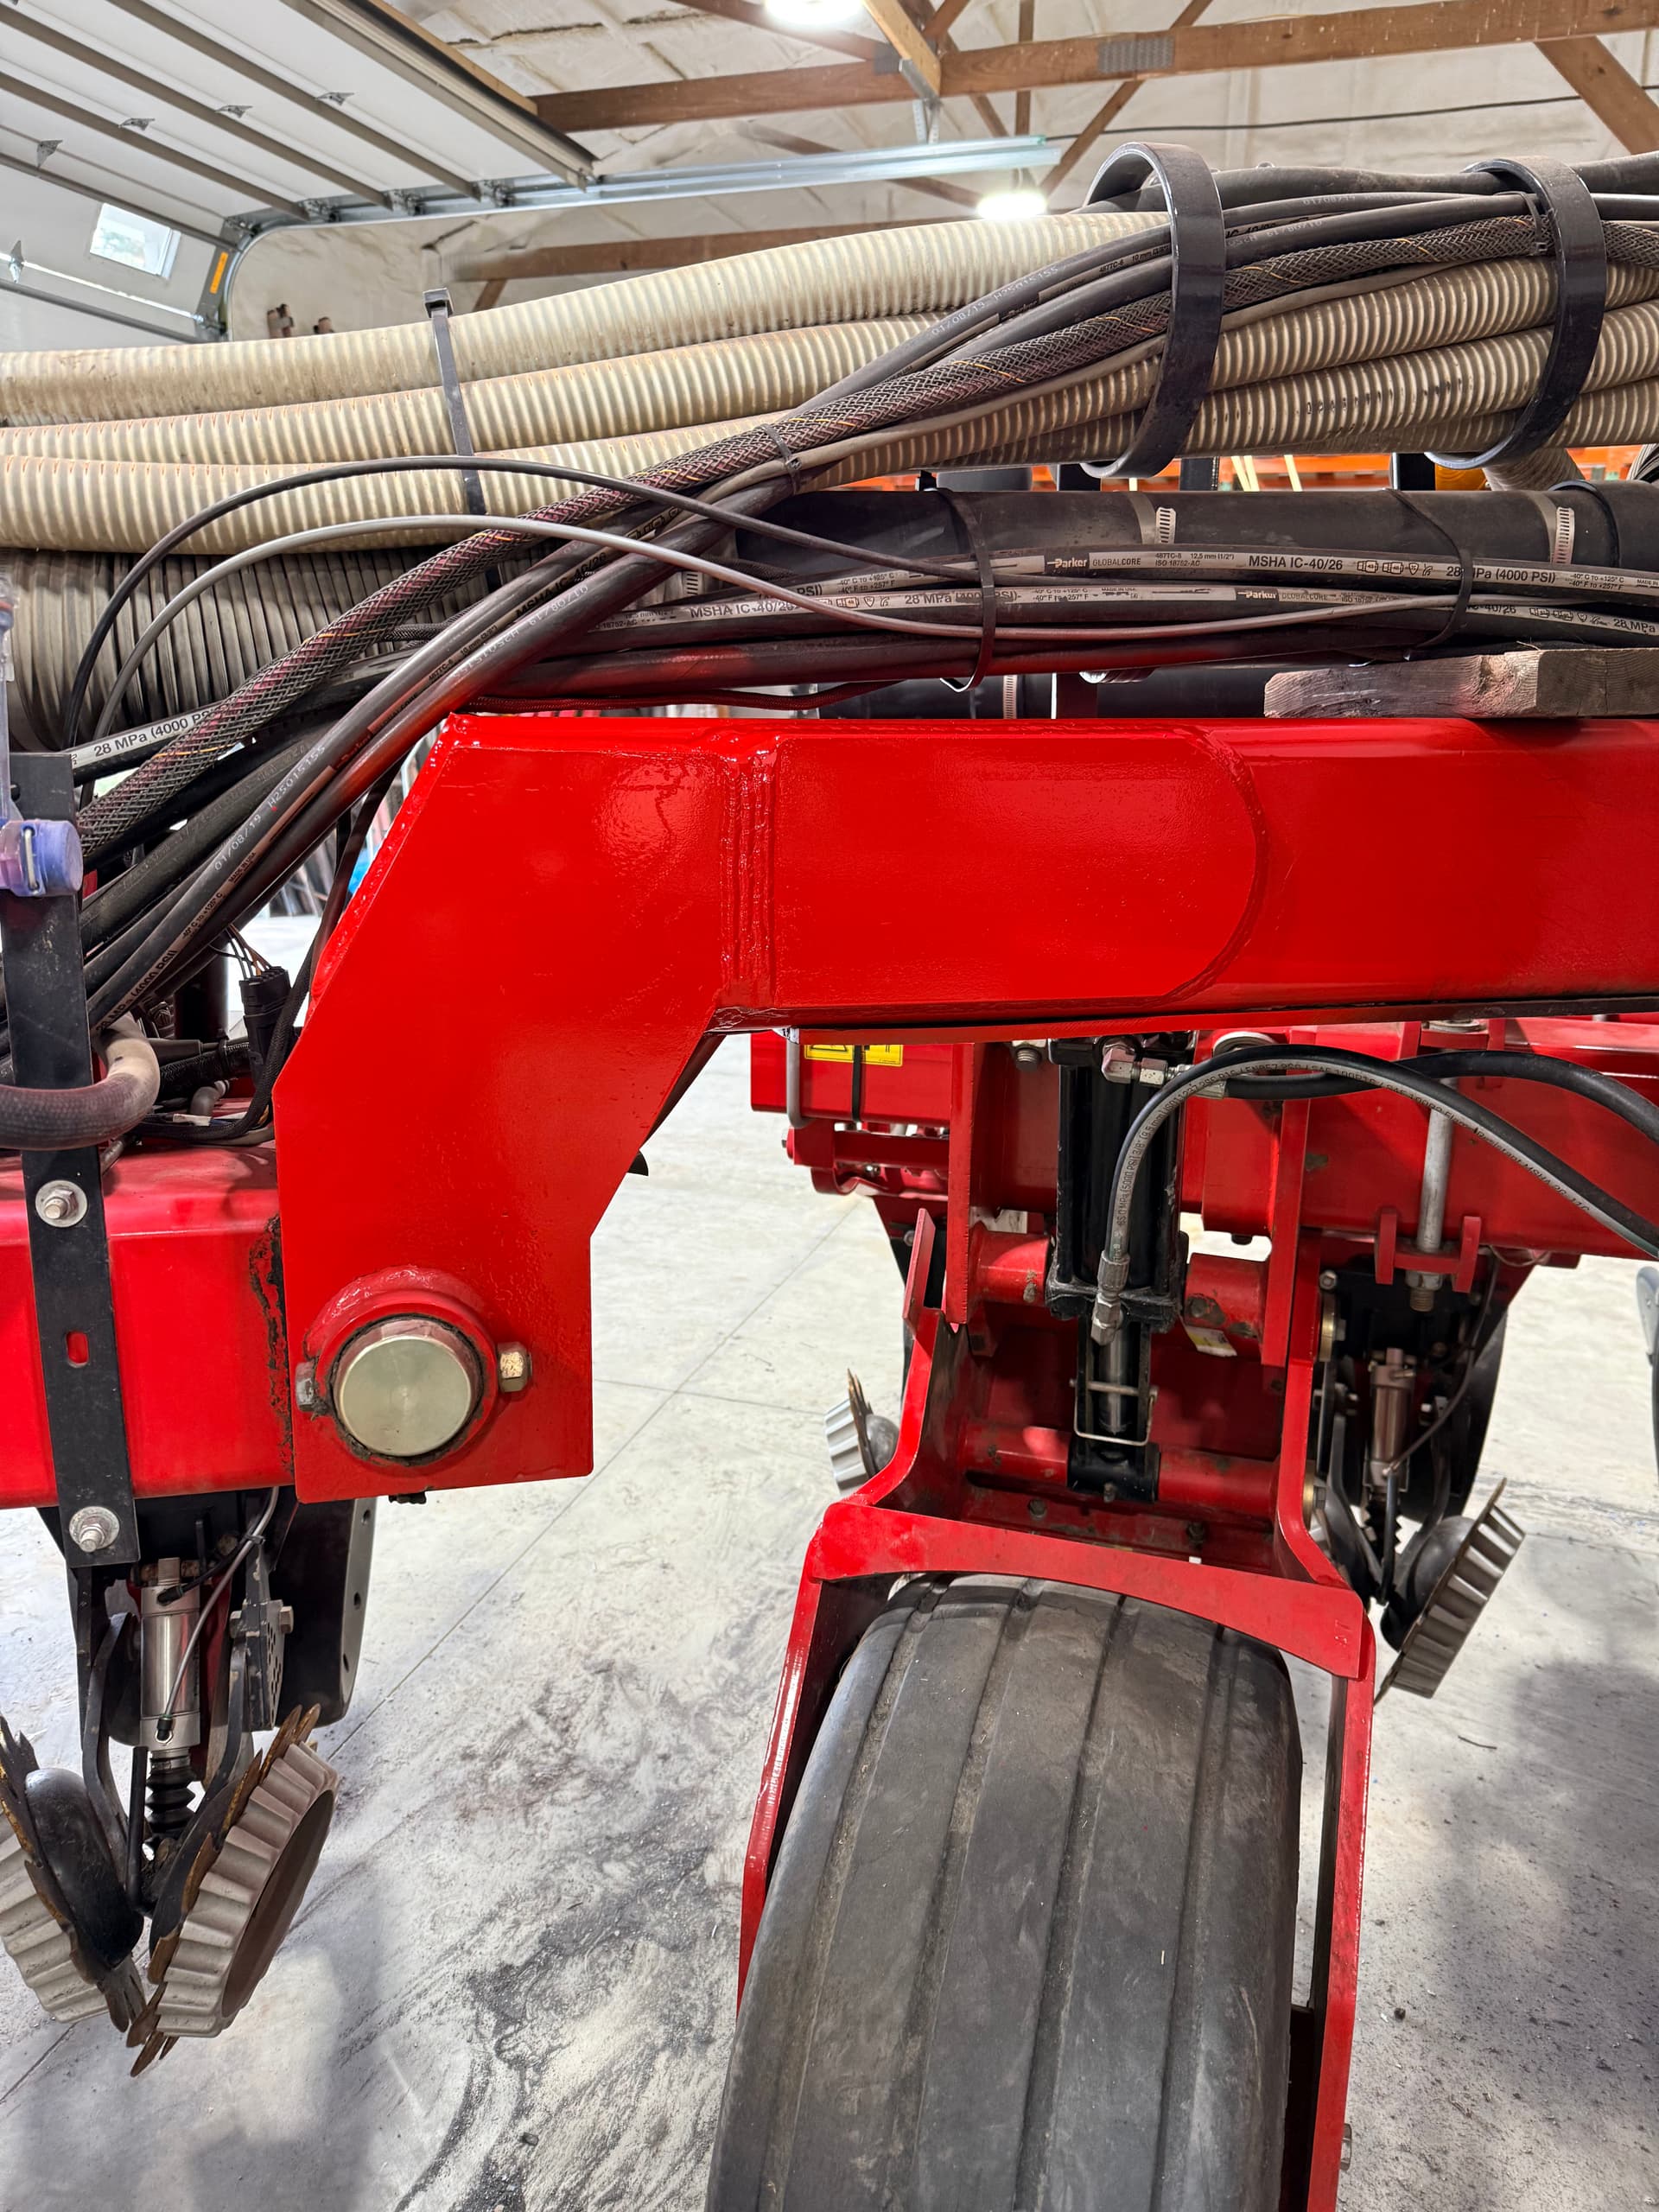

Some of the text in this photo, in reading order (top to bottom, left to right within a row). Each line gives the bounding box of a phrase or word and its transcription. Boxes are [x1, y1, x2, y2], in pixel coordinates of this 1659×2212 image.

[1054, 556, 1088, 569] Parker
[1092, 557, 1141, 567] GLOBALCORE
[1248, 555, 1287, 569] MSHA
[1290, 556, 1344, 571] IC-40/26
[1496, 569, 1529, 582] (4000
[1531, 570, 1556, 584] PSI)
[514, 587, 553, 617] MSHA
[690, 606, 733, 619] MSHA
[906, 594, 919, 605] 28
[924, 593, 951, 604] MPa
[93, 741, 111, 758] 28
[114, 734, 147, 752] MPa
[150, 717, 189, 740] (4000
[214, 813, 262, 871] 01/08/19
[1121, 1171, 1134, 1192] (5000
